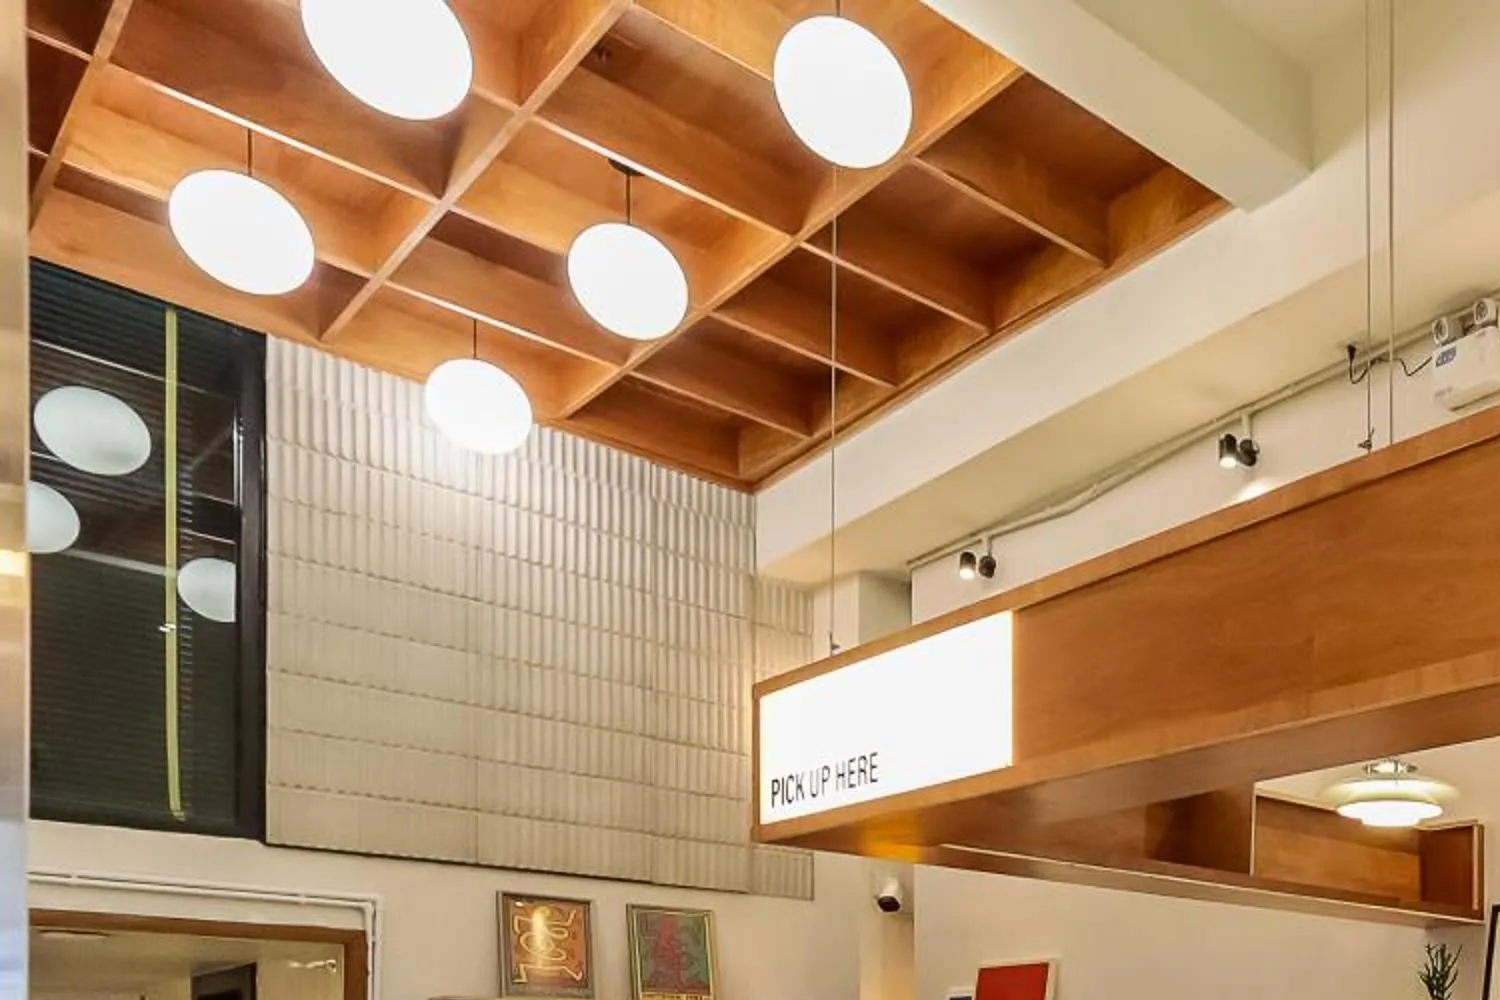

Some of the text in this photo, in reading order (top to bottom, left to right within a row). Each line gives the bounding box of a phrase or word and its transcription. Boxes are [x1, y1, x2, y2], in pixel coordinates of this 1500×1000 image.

[771, 752, 879, 808] PICK UP HERE
